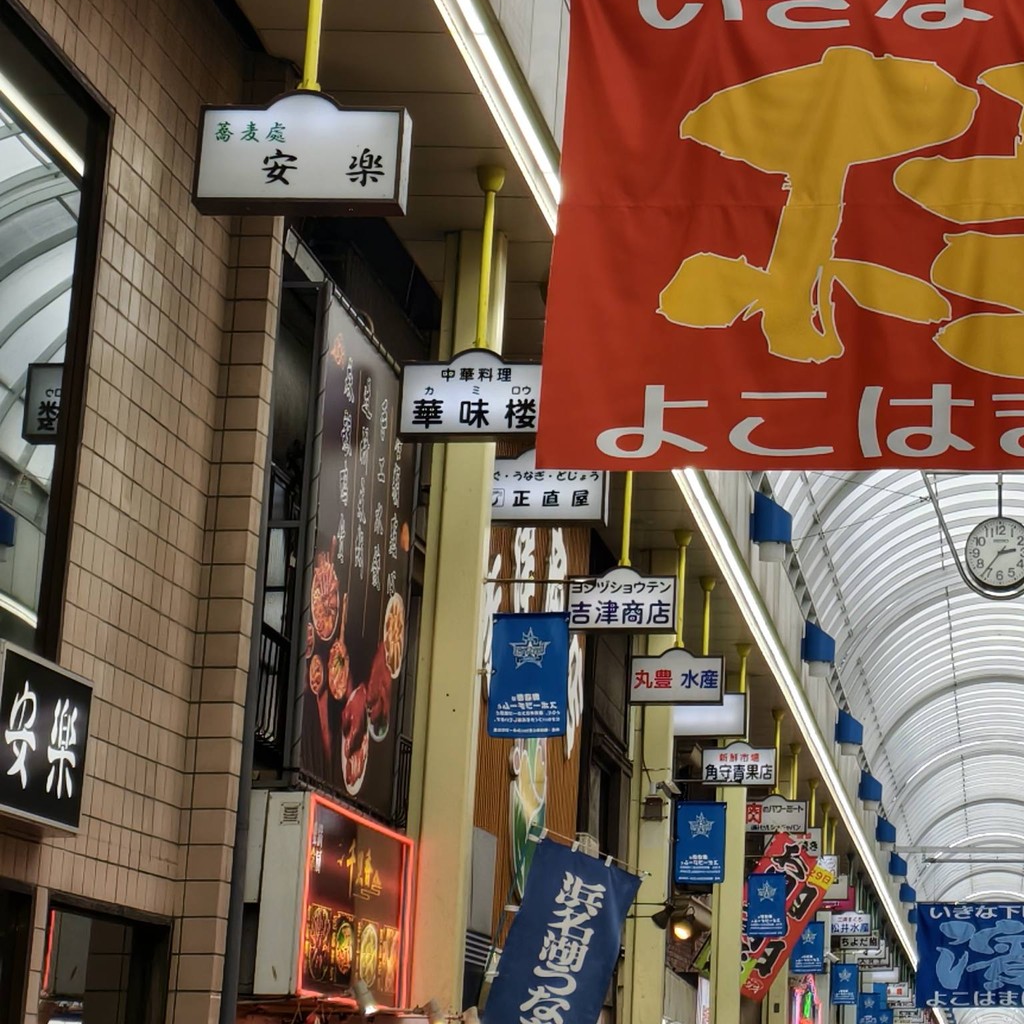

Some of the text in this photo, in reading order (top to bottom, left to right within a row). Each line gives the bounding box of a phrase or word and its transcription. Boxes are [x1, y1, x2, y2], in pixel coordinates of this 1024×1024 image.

[441, 368, 512, 382] 中華料理
[412, 398, 537, 430] 華味楼
[570, 599, 671, 625] 吉津商店
[634, 669, 719, 689] 丸豊 水産
[519, 871, 607, 1024] 浜名湖うな
